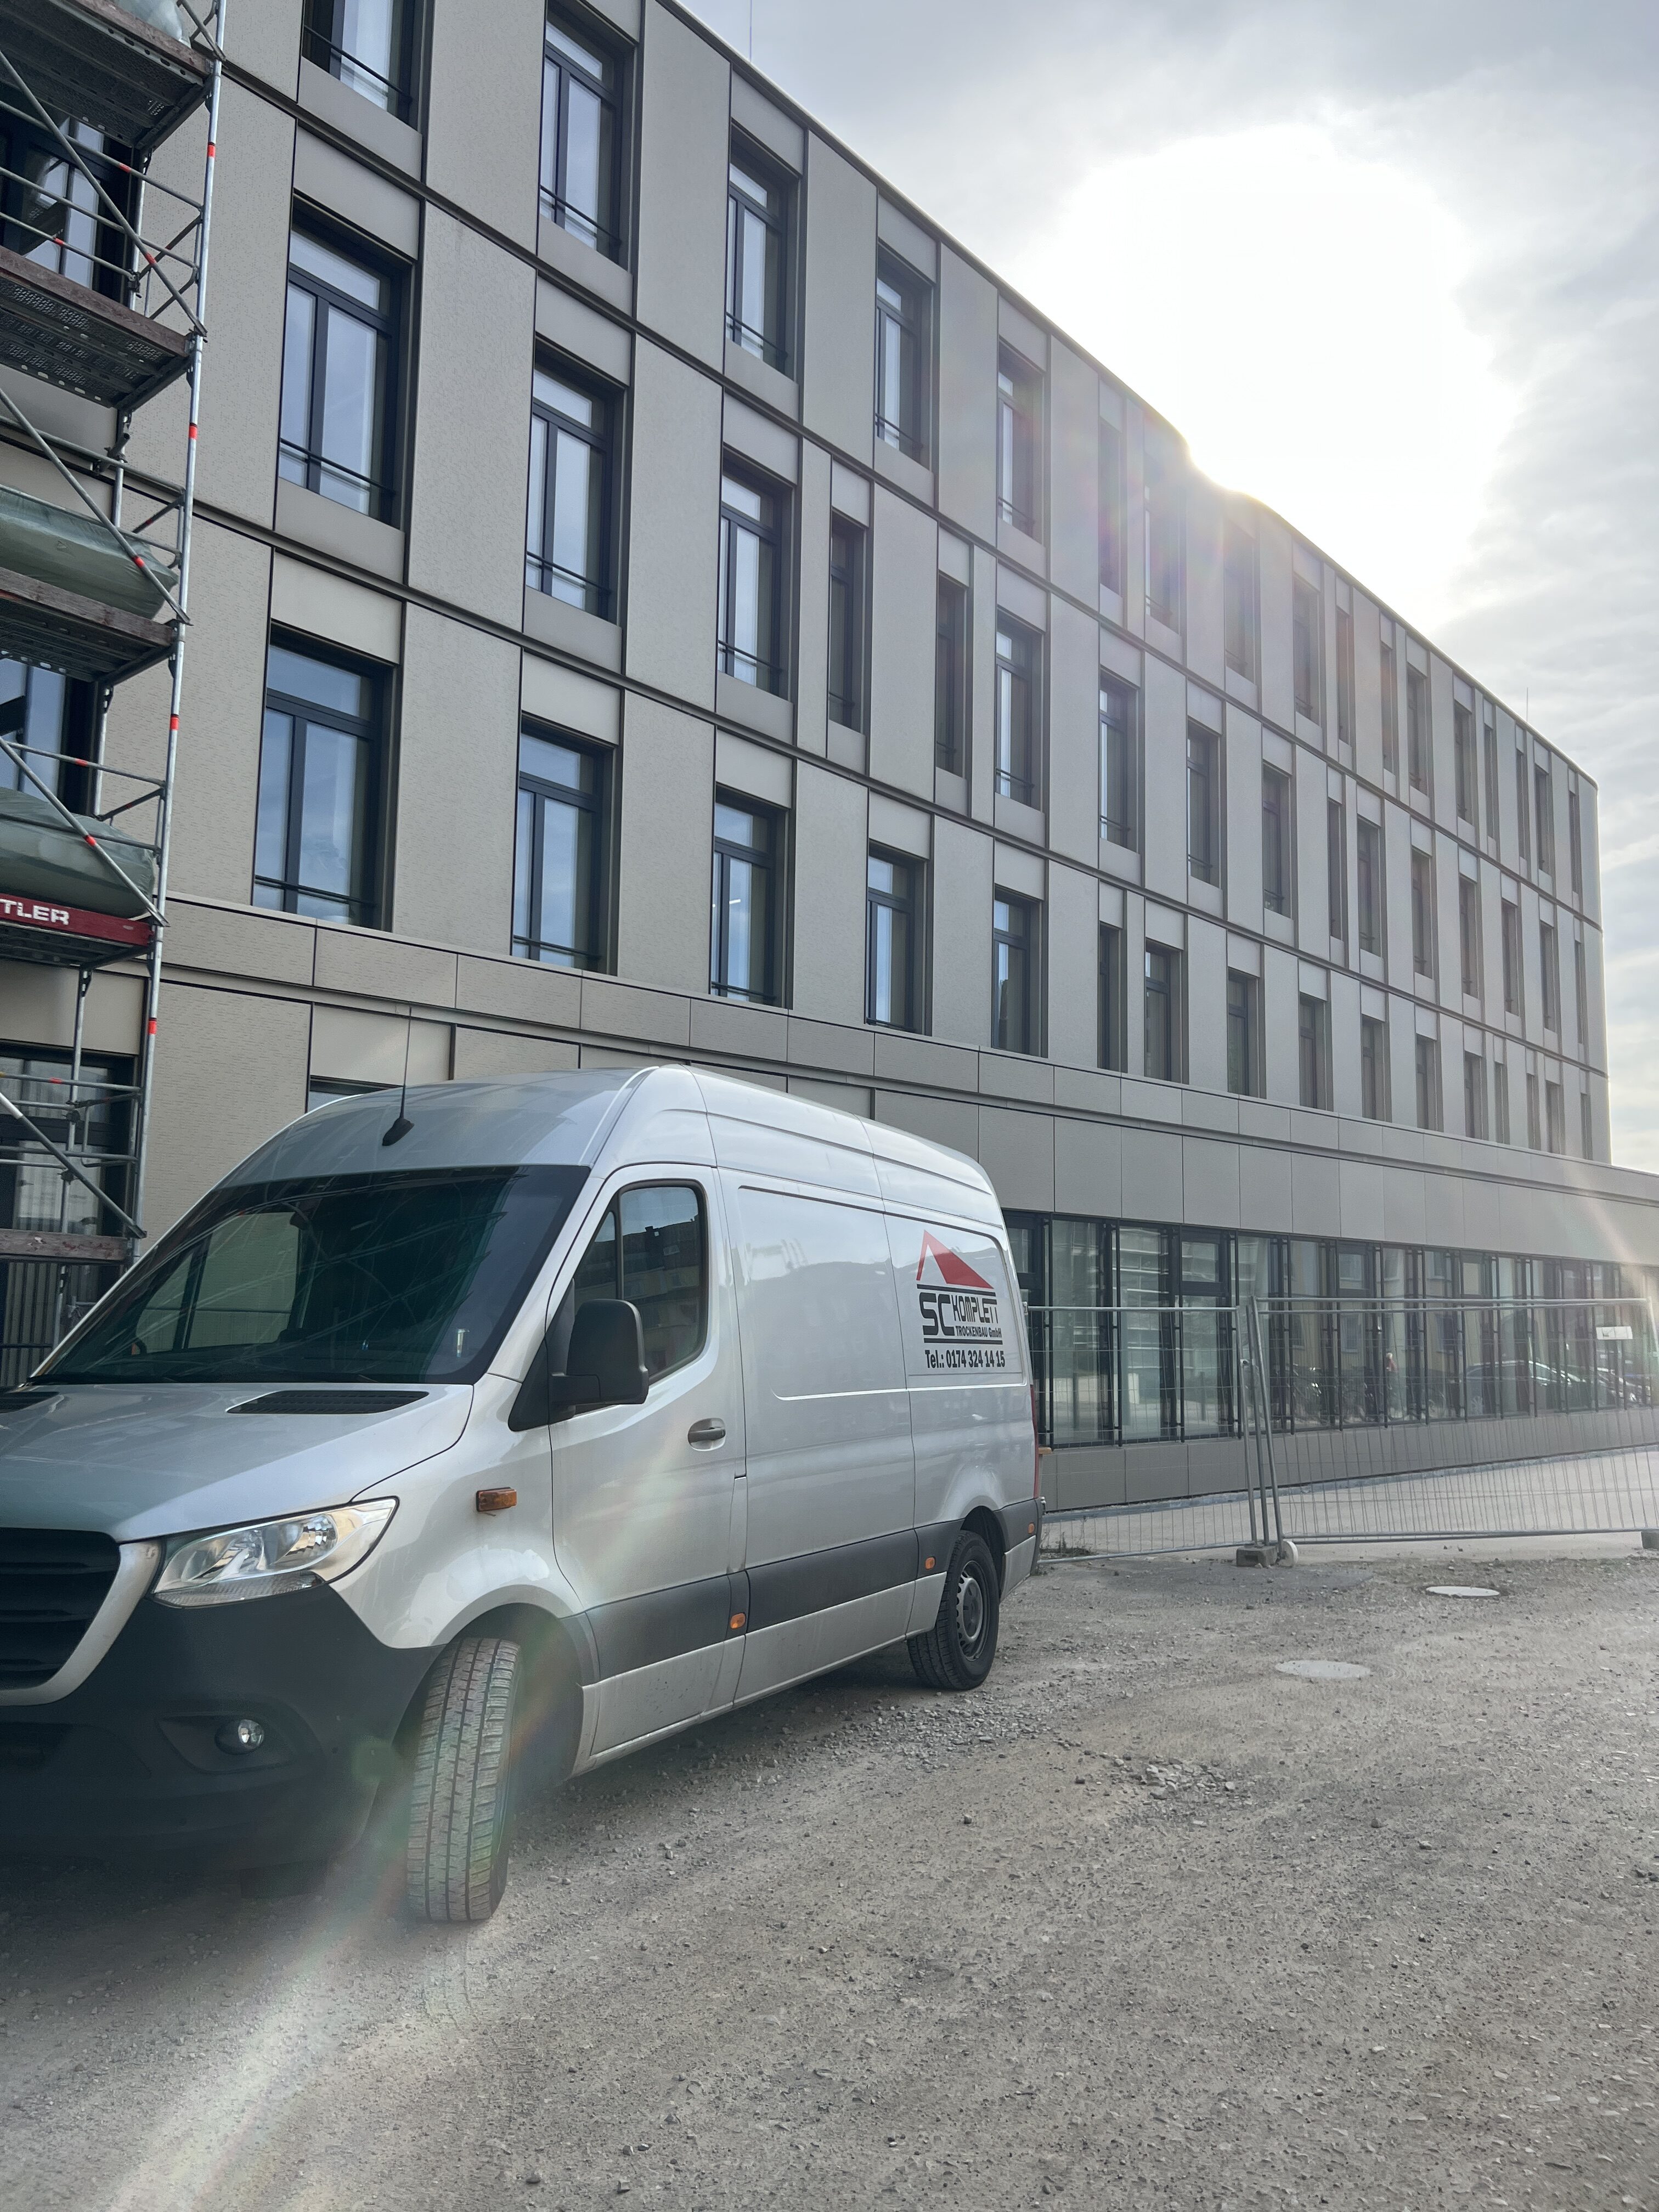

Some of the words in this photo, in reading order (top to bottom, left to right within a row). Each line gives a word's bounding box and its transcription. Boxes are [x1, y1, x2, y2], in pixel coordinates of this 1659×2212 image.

[919, 1292, 955, 1336] SC
[951, 1295, 998, 1324] KOMPLETT
[956, 1325, 988, 1338] TROCKENBAU
[989, 1327, 1002, 1338] GmbH
[925, 1350, 944, 1368] Tel.:
[946, 1350, 967, 1368] 0174
[968, 1350, 983, 1368] 324
[985, 1350, 995, 1368] 14
[996, 1350, 1005, 1368] 15
